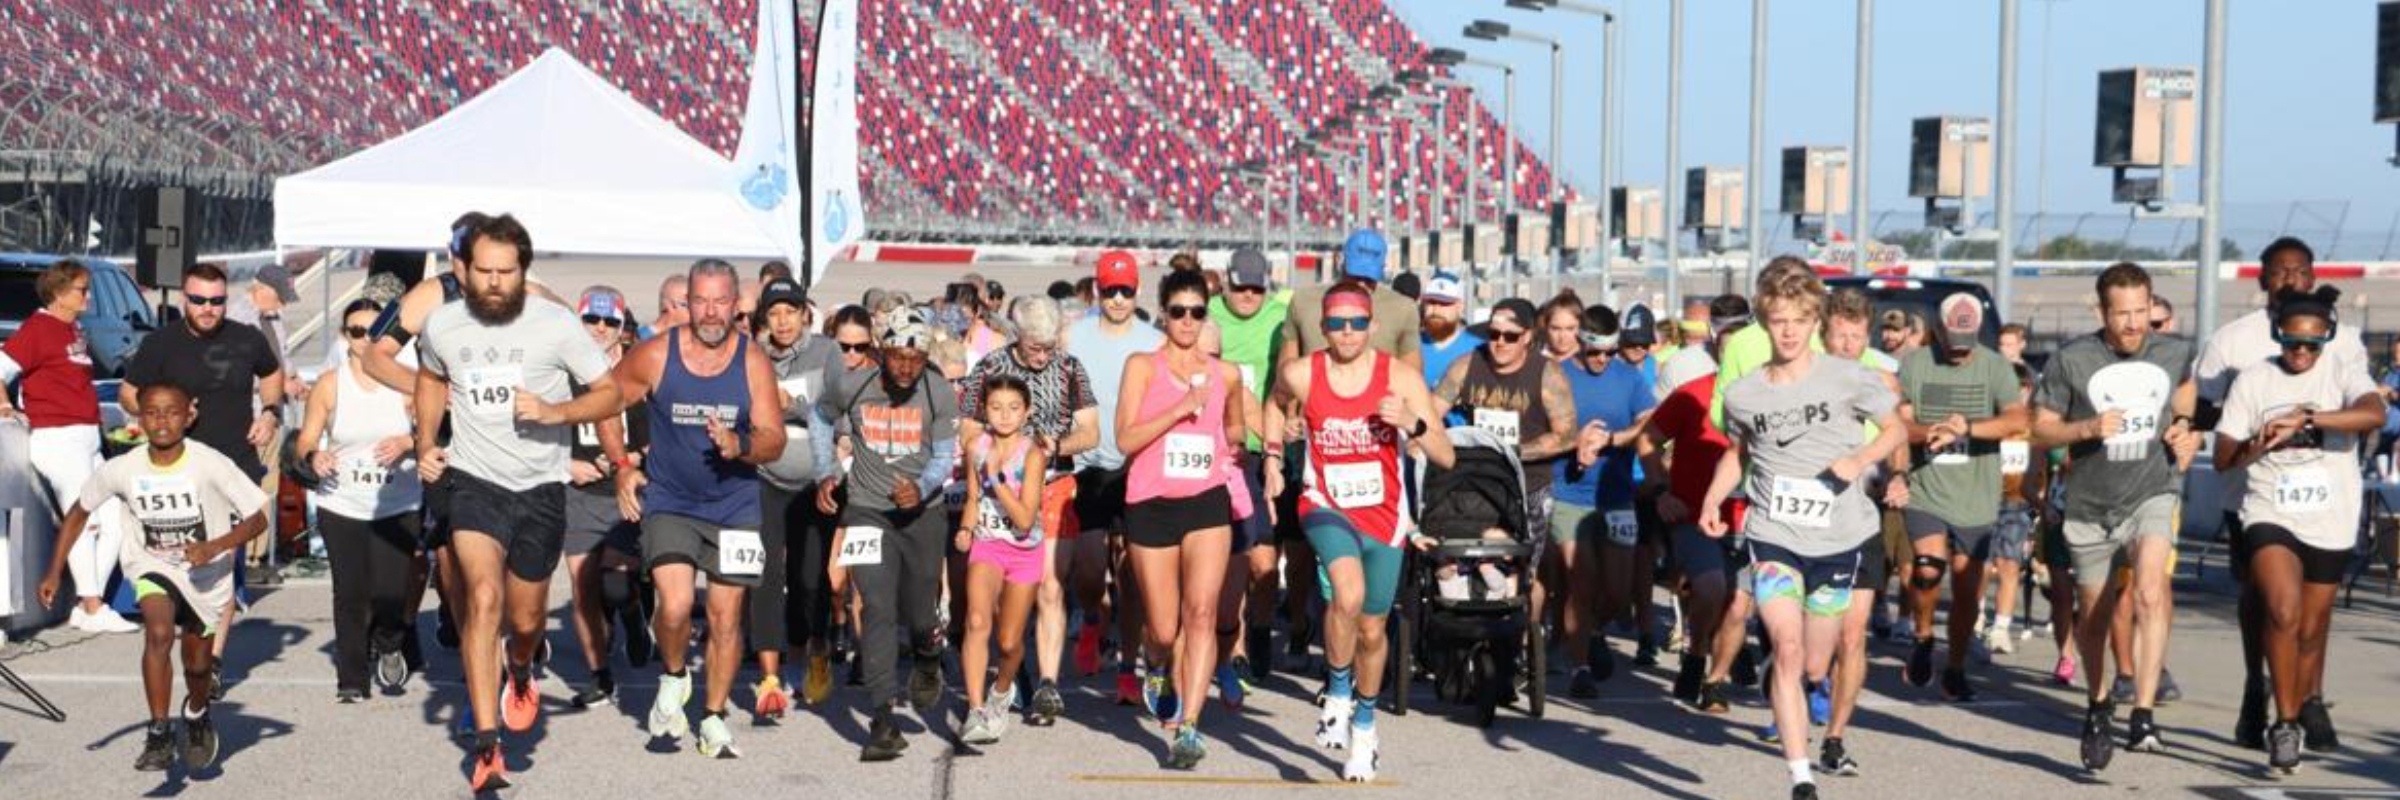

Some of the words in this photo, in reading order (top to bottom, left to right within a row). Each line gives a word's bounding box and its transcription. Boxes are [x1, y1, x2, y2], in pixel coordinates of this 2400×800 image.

[469, 385, 516, 405] 149
[2118, 414, 2154, 434] 354
[1167, 451, 1213, 470] 1399
[135, 491, 192, 512] 1511
[2276, 485, 2329, 505] 1479
[1775, 495, 1830, 517] 1377
[981, 513, 1014, 531] 139
